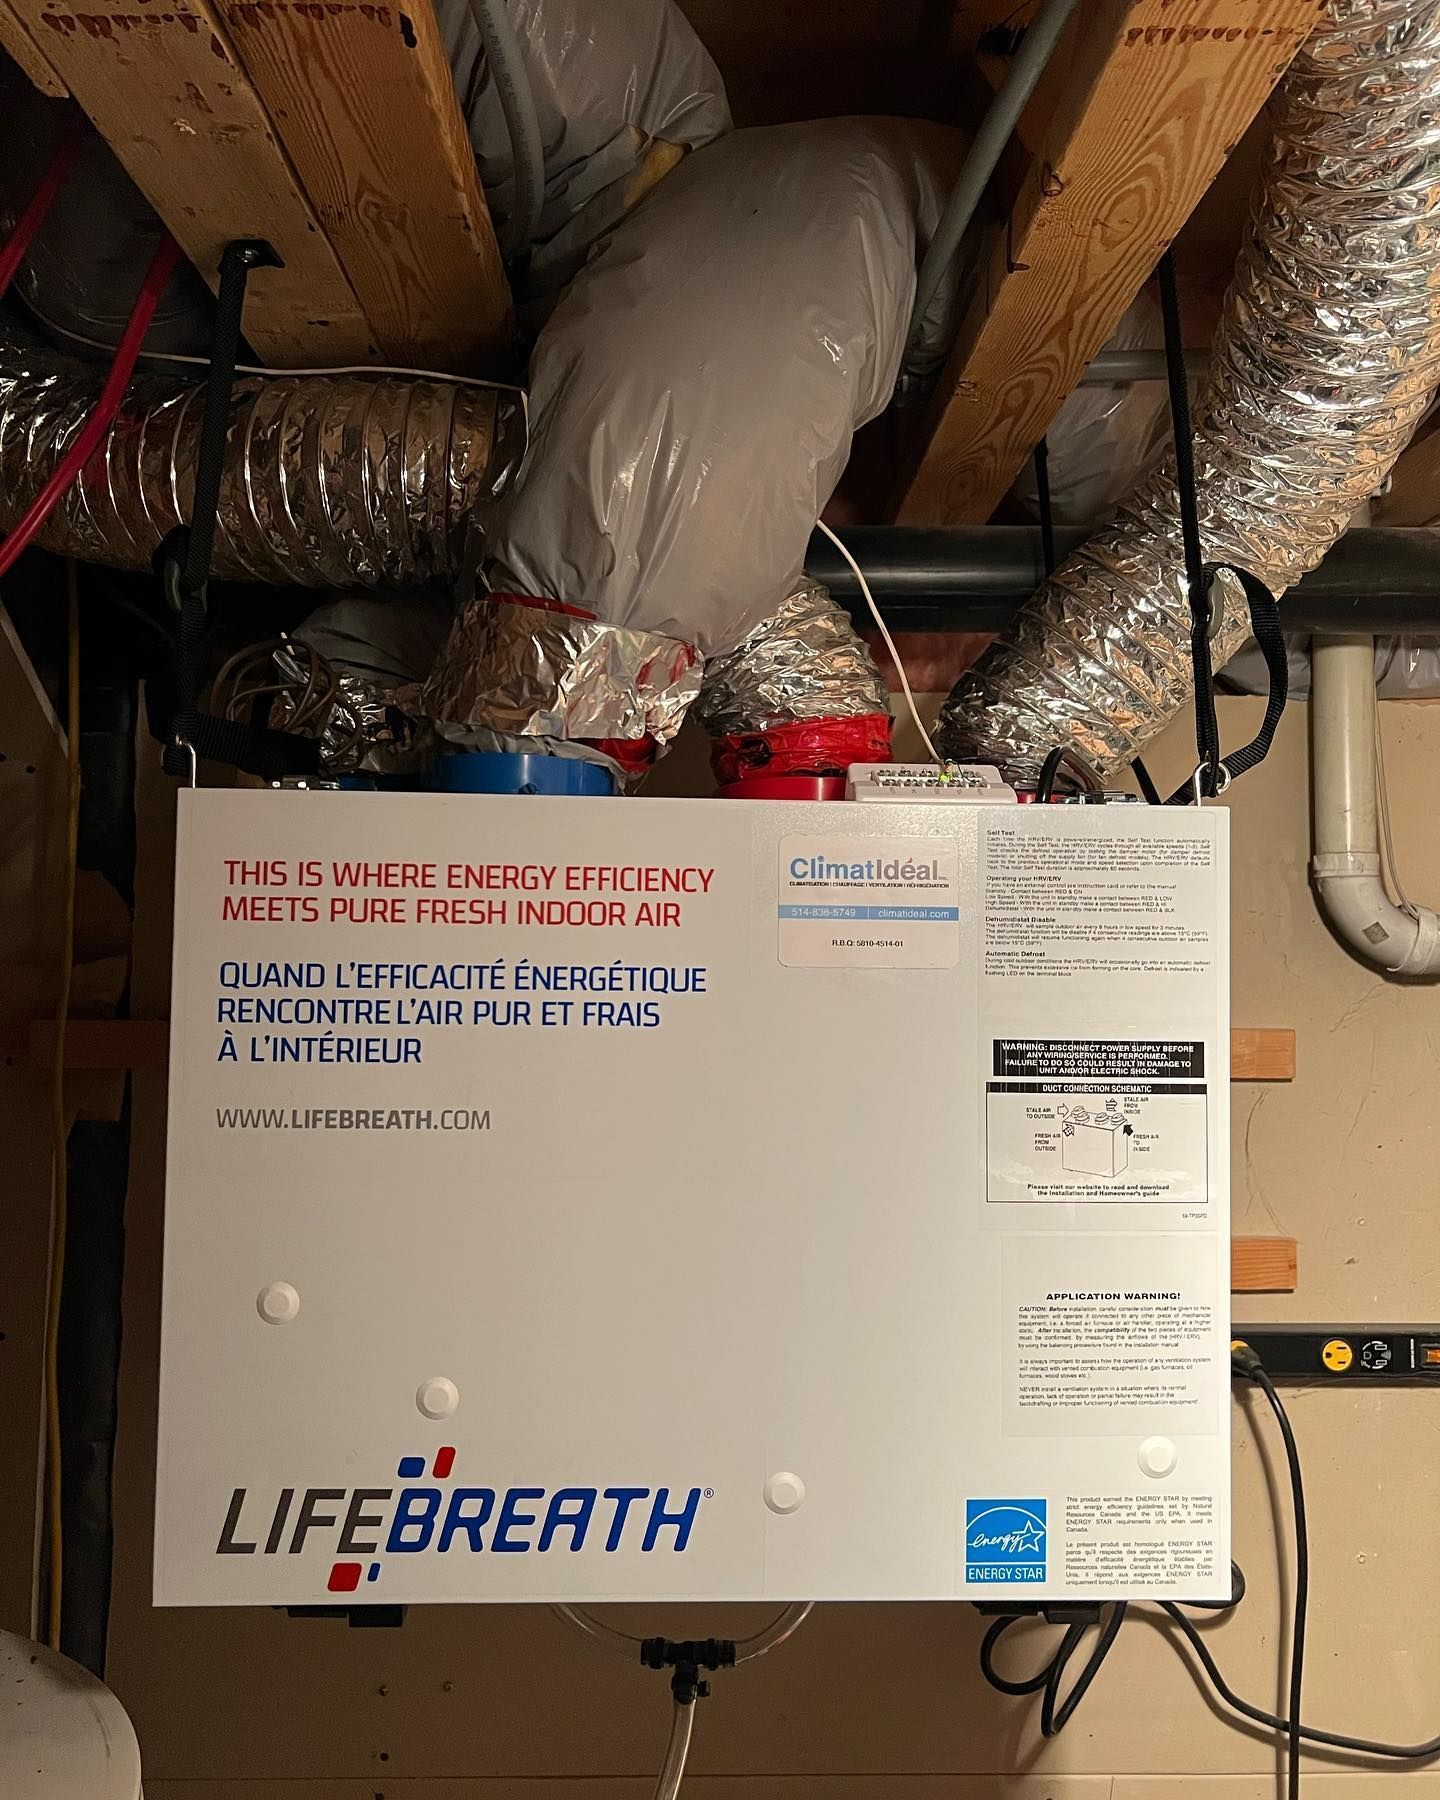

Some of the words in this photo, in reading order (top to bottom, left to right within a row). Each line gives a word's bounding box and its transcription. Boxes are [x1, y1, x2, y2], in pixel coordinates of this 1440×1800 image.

[223, 860, 288, 886] THIS
[298, 861, 323, 887] IS
[332, 862, 437, 888] WHERE
[447, 864, 557, 890] ENERGY
[566, 866, 714, 893] EFFICIENCY
[789, 855, 938, 880] ClimatIdéal
[221, 896, 320, 922] MEETS
[330, 898, 406, 923] PURE
[416, 899, 507, 925] FRESH
[518, 900, 626, 926] INDOOR
[635, 902, 680, 927] AIR
[792, 908, 856, 917] 514-838-5749
[878, 909, 949, 918] climatideal.com
[220, 962, 324, 990] QUAND
[337, 957, 504, 990] L'EFFICACITÉ
[515, 959, 706, 994] ÉNERGÉTIQUE
[218, 998, 391, 1025] RENCONTRE
[397, 998, 463, 1025] L'AIR
[474, 1001, 531, 1026] PUR
[542, 1001, 574, 1026] ET
[583, 1002, 660, 1027] FRAIS
[218, 1030, 237, 1062] À
[251, 1030, 421, 1063] L'INTÉRIEUR
[1002, 1043, 1047, 1052] WARNING:
[1050, 1043, 1100, 1052] DISCONNECT
[1101, 1043, 1131, 1052] POWER
[1131, 1044, 1161, 1052] SUPPLY
[1044, 1052, 1107, 1060] WIRING/SERVICE
[1118, 1052, 1168, 1060] PERFORMED.
[1005, 1059, 1037, 1067] FAILURE
[1064, 1084, 1110, 1092] CONNECTION
[1112, 1085, 1151, 1093] SCHEMATIC
[215, 1108, 490, 1130] WWW.LIFEBREATH.COM
[967, 1532, 1021, 1553] energy
[969, 1568, 1013, 1580] ENERGY
[1015, 1568, 1043, 1579] STAR
